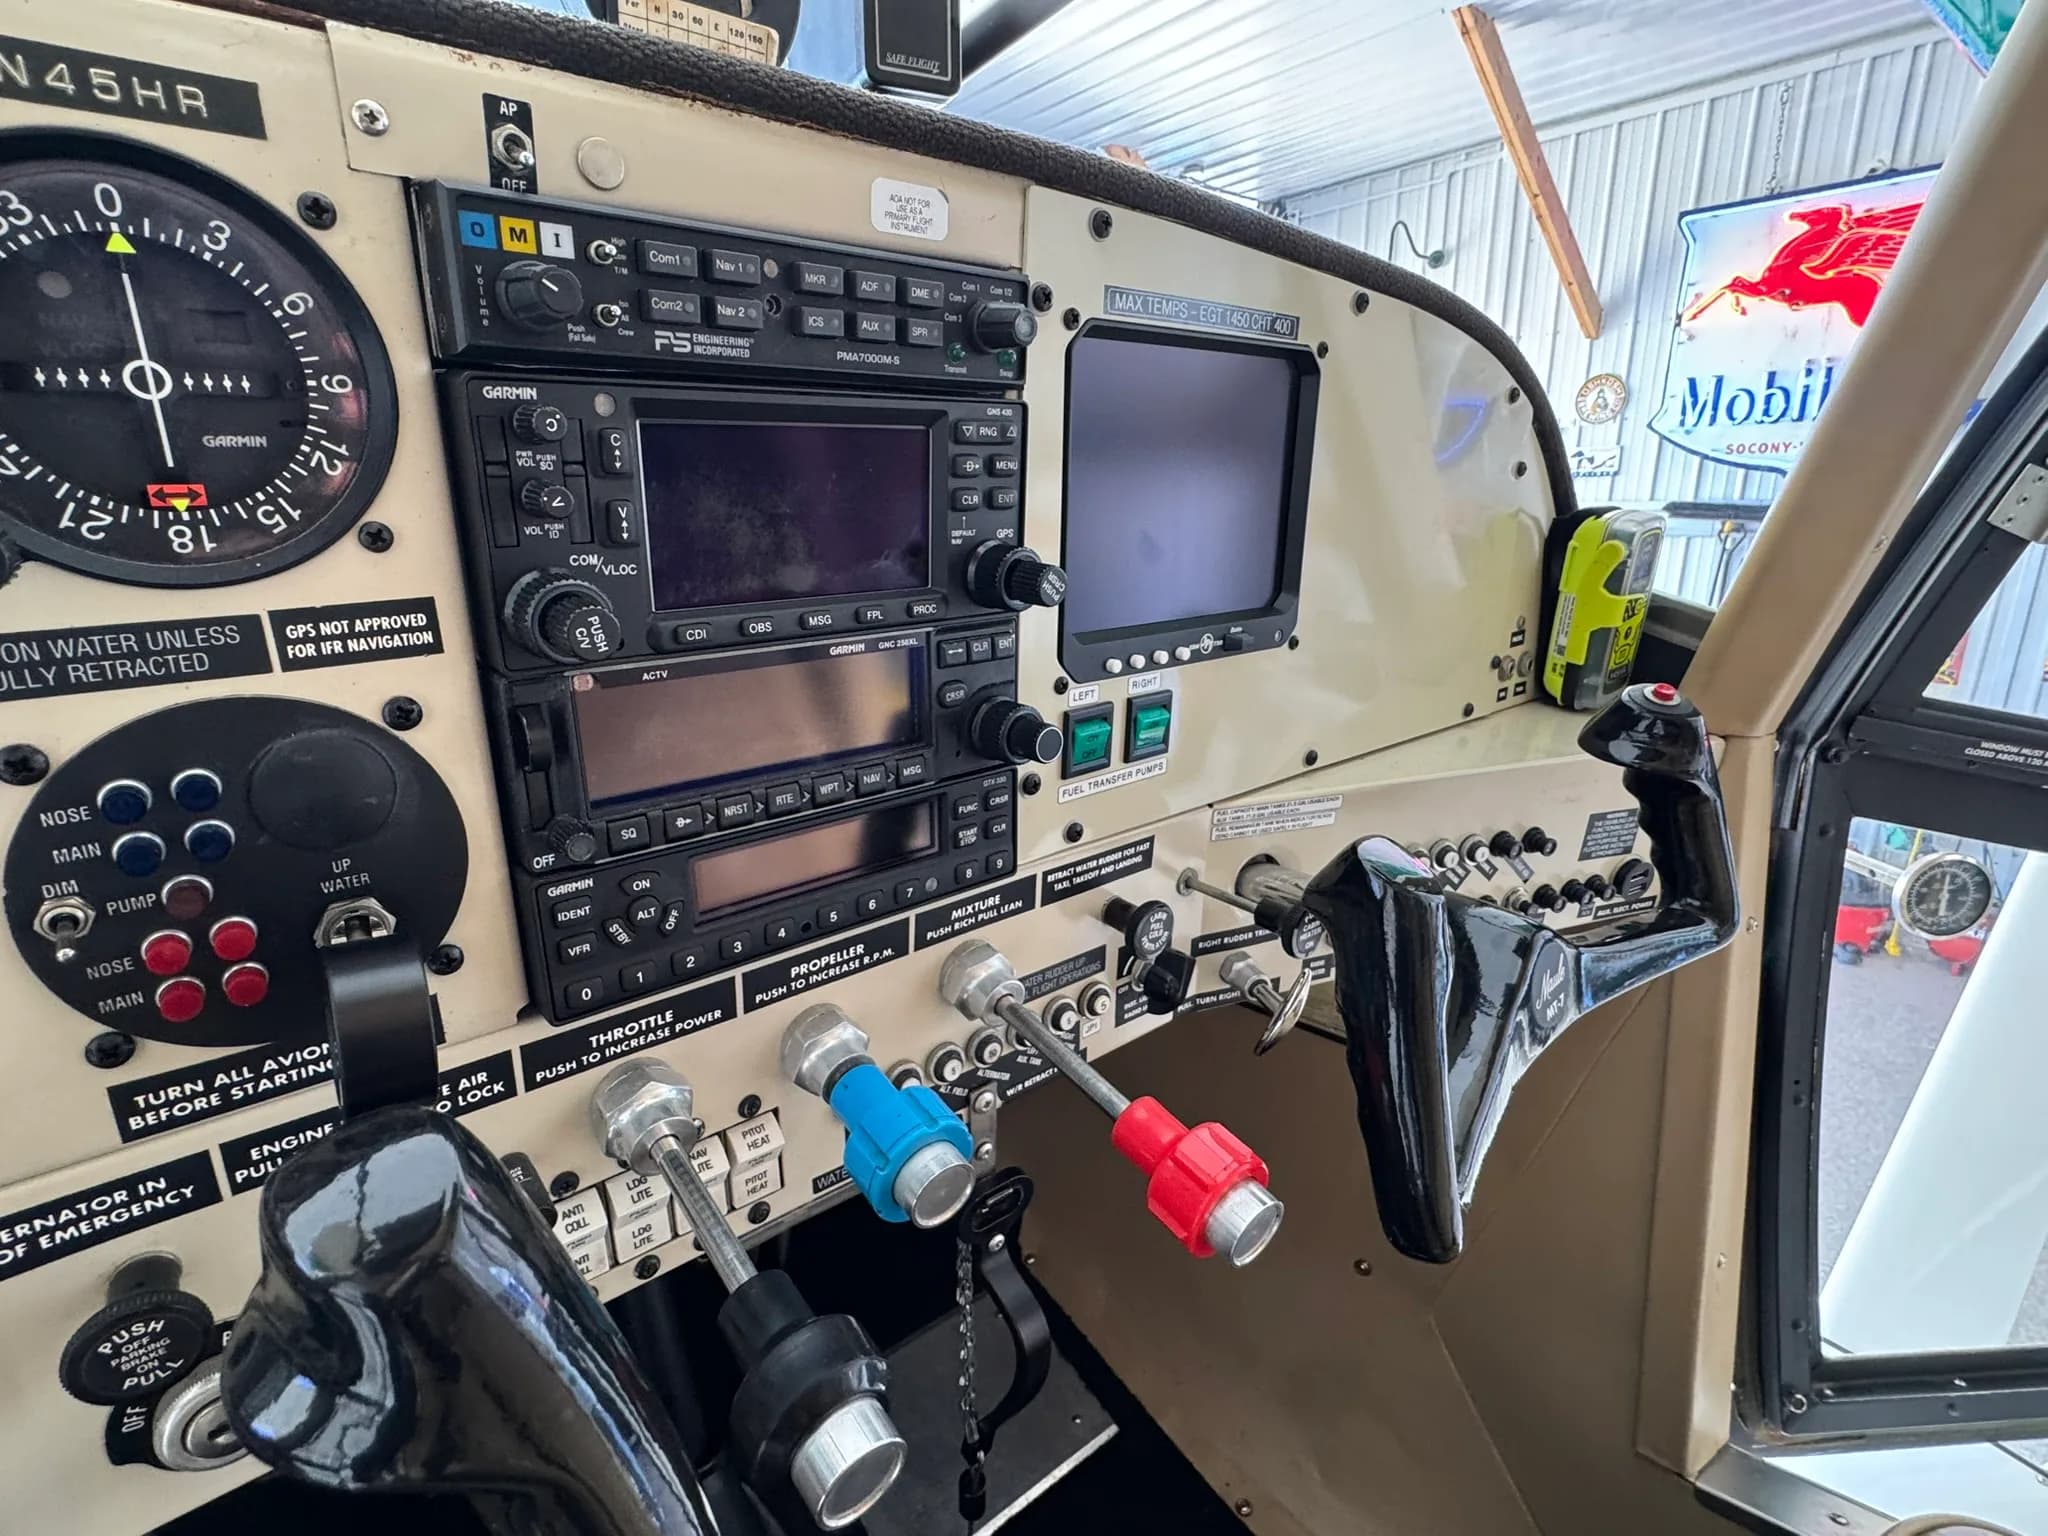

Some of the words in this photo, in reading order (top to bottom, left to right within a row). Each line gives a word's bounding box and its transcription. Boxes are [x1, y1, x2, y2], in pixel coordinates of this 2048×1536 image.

[672, 10, 684, 21] 30
[692, 15, 704, 26] 60
[714, 22, 720, 31] E
[729, 27, 744, 39] 120
[748, 33, 763, 45] 150
[886, 52, 906, 65] SAFE
[909, 56, 940, 73] FLIGHT
[0, 53, 209, 118] N45HR
[499, 102, 517, 117] AP
[502, 177, 527, 193] OFF
[94, 182, 122, 218] 0
[890, 194, 902, 203] AOA
[904, 197, 916, 206] NOT
[918, 199, 930, 208] FOR
[884, 210, 911, 222] PRIMARY
[913, 215, 933, 226] FLIGHT
[896, 204, 908, 213] USE
[909, 207, 918, 215] AS
[203, 220, 231, 252] 3
[891, 221, 928, 234] INSTRUMENT
[805, 272, 826, 286] MKR
[860, 280, 880, 293] ADF
[475, 264, 489, 327] Volume
[911, 286, 930, 299] DME
[808, 316, 825, 328] ICS
[1115, 292, 1144, 313] MAX
[1147, 296, 1189, 318] TEMPS
[1200, 305, 1223, 323] EGT
[1226, 310, 1250, 329] 1450
[1251, 313, 1273, 332] CHT
[1274, 318, 1291, 335] 400
[861, 320, 880, 333] AUX
[911, 325, 929, 339] SPR
[654, 330, 692, 353] PS
[693, 345, 751, 358] INCORPORATED
[836, 350, 901, 366] PMA7000M-S
[482, 385, 538, 400] GARMIN
[1680, 367, 1834, 428] Mobil
[202, 434, 268, 449] GARMIN
[1725, 441, 1803, 456] SOCONY-
[168, 524, 217, 554] 18
[951, 529, 976, 537] DEFAULT
[285, 623, 317, 640] GPS
[320, 619, 350, 637] NOT
[354, 613, 427, 634] APPROVED
[749, 621, 772, 634] OBS
[809, 614, 833, 627] MSG
[3, 641, 40, 663] ON
[47, 633, 138, 660] WATER
[148, 625, 240, 652] UNLESS
[686, 629, 707, 641] CDI
[286, 643, 317, 660] FOR
[320, 639, 345, 656] IFR
[347, 631, 433, 653] NAVIGATION
[68, 652, 209, 684] RETRACTED
[642, 671, 668, 681] ACTV
[1132, 677, 1158, 690] RIGHT
[1073, 689, 1095, 701] LEFT
[1964, 747, 1996, 758] CLOSED
[1995, 753, 2025, 763] ABOVE
[2026, 757, 2043, 766] 120
[1980, 741, 2020, 753] WINDOW
[2020, 748, 2044, 757] MUST
[863, 772, 881, 784] NAV
[1062, 785, 1085, 798] FUEL
[1087, 770, 1133, 793] TRANSFER
[1136, 761, 1165, 778] PUMPS
[819, 782, 839, 795] WPT
[775, 793, 794, 806] RTE
[40, 806, 92, 828] NOSE
[621, 828, 637, 840] SQ
[52, 842, 102, 865] MAIN
[533, 854, 555, 869] OFF
[1047, 867, 1075, 883] RETRACT
[1075, 859, 1098, 874] WATER
[1099, 851, 1123, 866] RUDDER
[1123, 847, 1136, 857] FOR
[1136, 842, 1150, 853] FAST
[332, 857, 352, 874] UP
[1054, 879, 1072, 892] TAXI,
[1073, 869, 1100, 888] TAKEOFF
[1101, 864, 1115, 876] AND
[1115, 855, 1143, 872] LANDING
[41, 880, 80, 899] DIM
[320, 871, 370, 895] WATER
[547, 877, 594, 897] GARMIN
[633, 879, 650, 892] ON
[106, 893, 157, 916] PUMP
[951, 894, 1001, 920] MIXTURE
[557, 906, 592, 922] IDENT
[637, 907, 656, 921] ALT
[665, 909, 680, 930] OFF
[926, 926, 951, 940] PUSH
[954, 916, 976, 930] RICH
[977, 909, 998, 923] PULL
[1000, 900, 1023, 914] LEAN
[1150, 911, 1168, 922] CABIN
[609, 923, 632, 945] STBY
[568, 944, 591, 957] VFR
[86, 957, 135, 981] NOSE
[790, 943, 865, 979] PROPELLER
[755, 986, 788, 1004] PUSH
[790, 979, 806, 991] TO
[809, 959, 861, 985] INCREASE
[863, 948, 895, 965] R.P.M.
[1024, 973, 1043, 986] ATER
[1044, 962, 1075, 980] RUDDER
[1076, 957, 1086, 968] UP
[98, 991, 145, 1015] MAIN
[588, 1010, 674, 1049] THROTTLE
[535, 1060, 577, 1082] PUSH
[581, 1052, 601, 1067] TO
[605, 1027, 671, 1057] INCREASE
[674, 1009, 723, 1034] POWER
[458, 1071, 488, 1091] AIR
[977, 1069, 1011, 1081] ALTERNATOR
[1006, 1083, 1023, 1097] W/R
[1024, 1068, 1053, 1088] RETRACT
[133, 1079, 205, 1109] TURN
[213, 1066, 254, 1088] ALL
[458, 1081, 505, 1106] LOCK
[128, 1096, 222, 1131] BEFORE
[742, 1124, 767, 1139] PITOT
[747, 1135, 771, 1151] HEAT
[138, 1177, 166, 1195] IN
[626, 1176, 648, 1191] LDG
[745, 1170, 768, 1186] PITOT
[631, 1188, 654, 1204] LITE
[747, 1181, 769, 1196] HEAT
[39, 1185, 195, 1250] EMERGENCY
[562, 1203, 584, 1221] ANTI
[565, 1217, 590, 1234] COLL
[632, 1224, 653, 1239] LDG
[633, 1235, 655, 1250] LITE
[97, 1319, 166, 1355] PUSH
[121, 1336, 151, 1354] OFF
[110, 1337, 171, 1367] PARKING
[121, 1348, 167, 1371] BRAKE
[122, 1358, 184, 1391] PULL
[137, 1360, 160, 1373] ON
[121, 1405, 148, 1433] OFF
